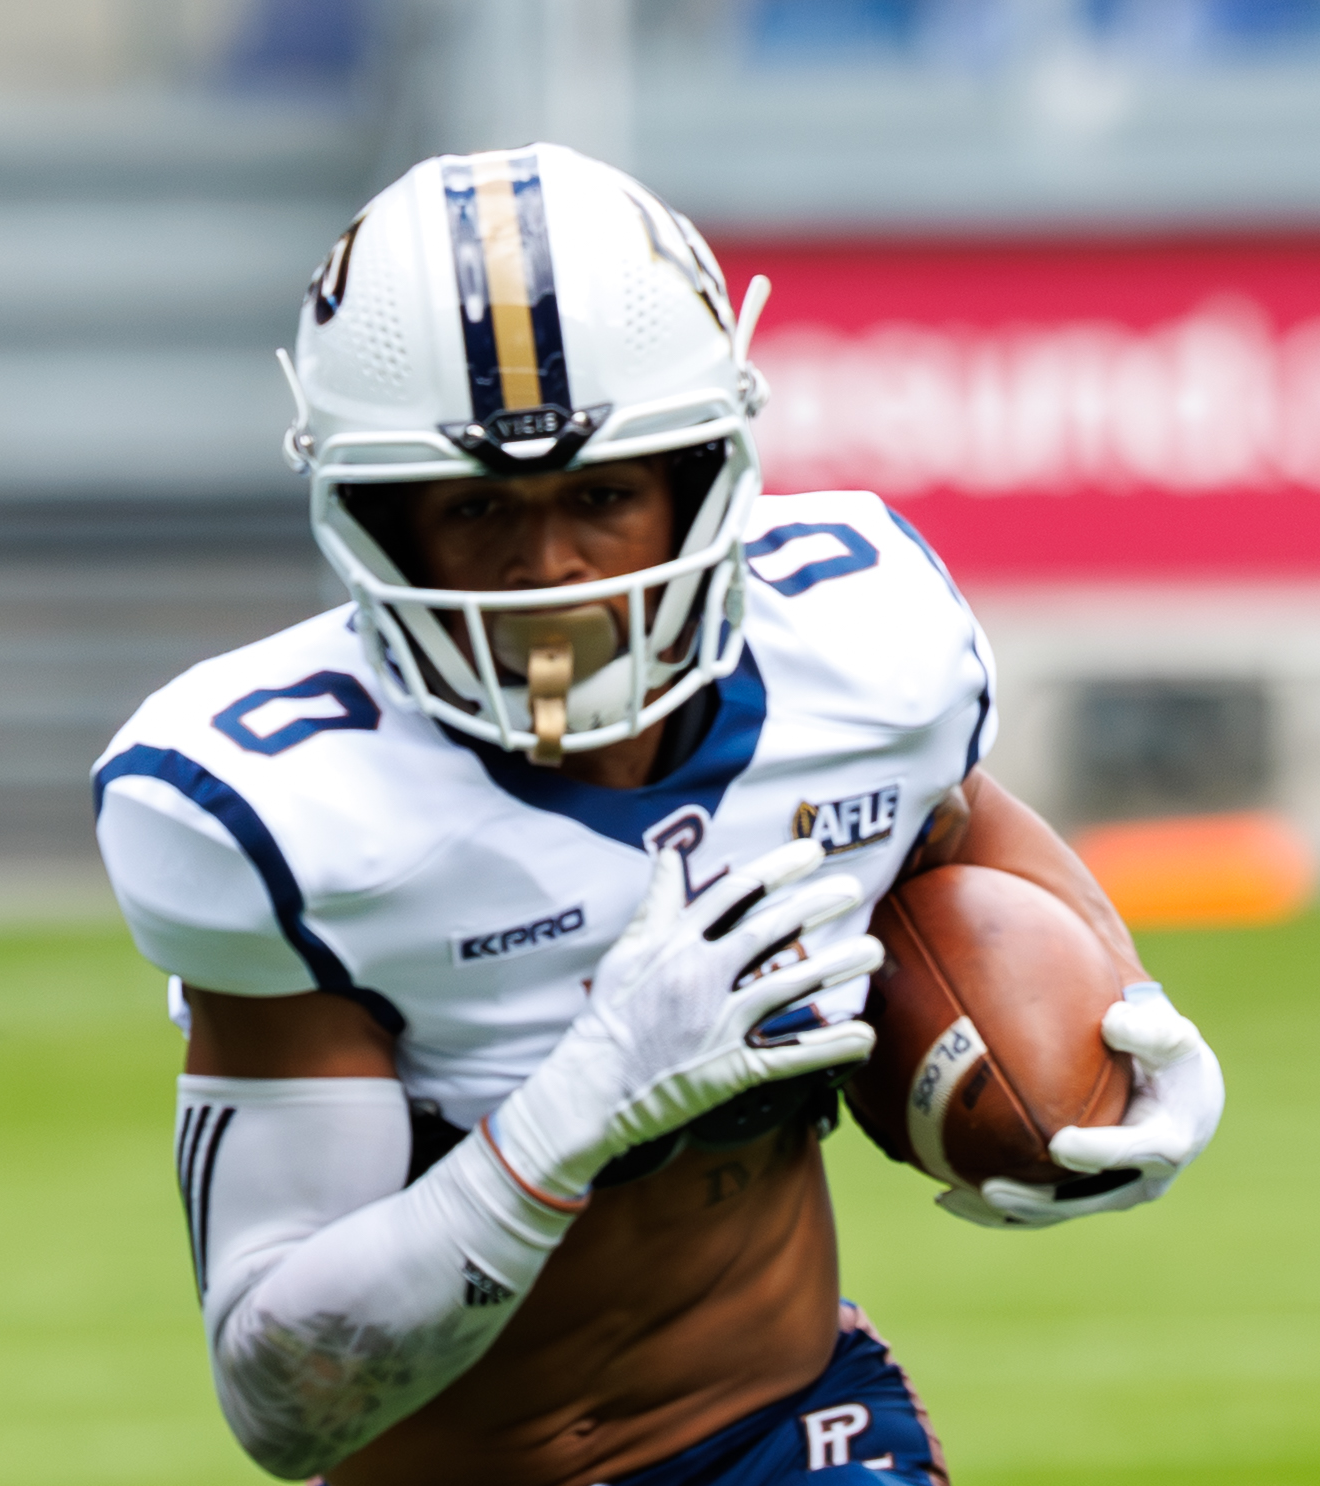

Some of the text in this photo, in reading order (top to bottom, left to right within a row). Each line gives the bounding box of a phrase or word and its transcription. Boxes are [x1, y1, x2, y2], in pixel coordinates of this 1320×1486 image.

[745, 522, 880, 598] 0
[210, 670, 382, 758] 0
[809, 788, 899, 848] AFLE
